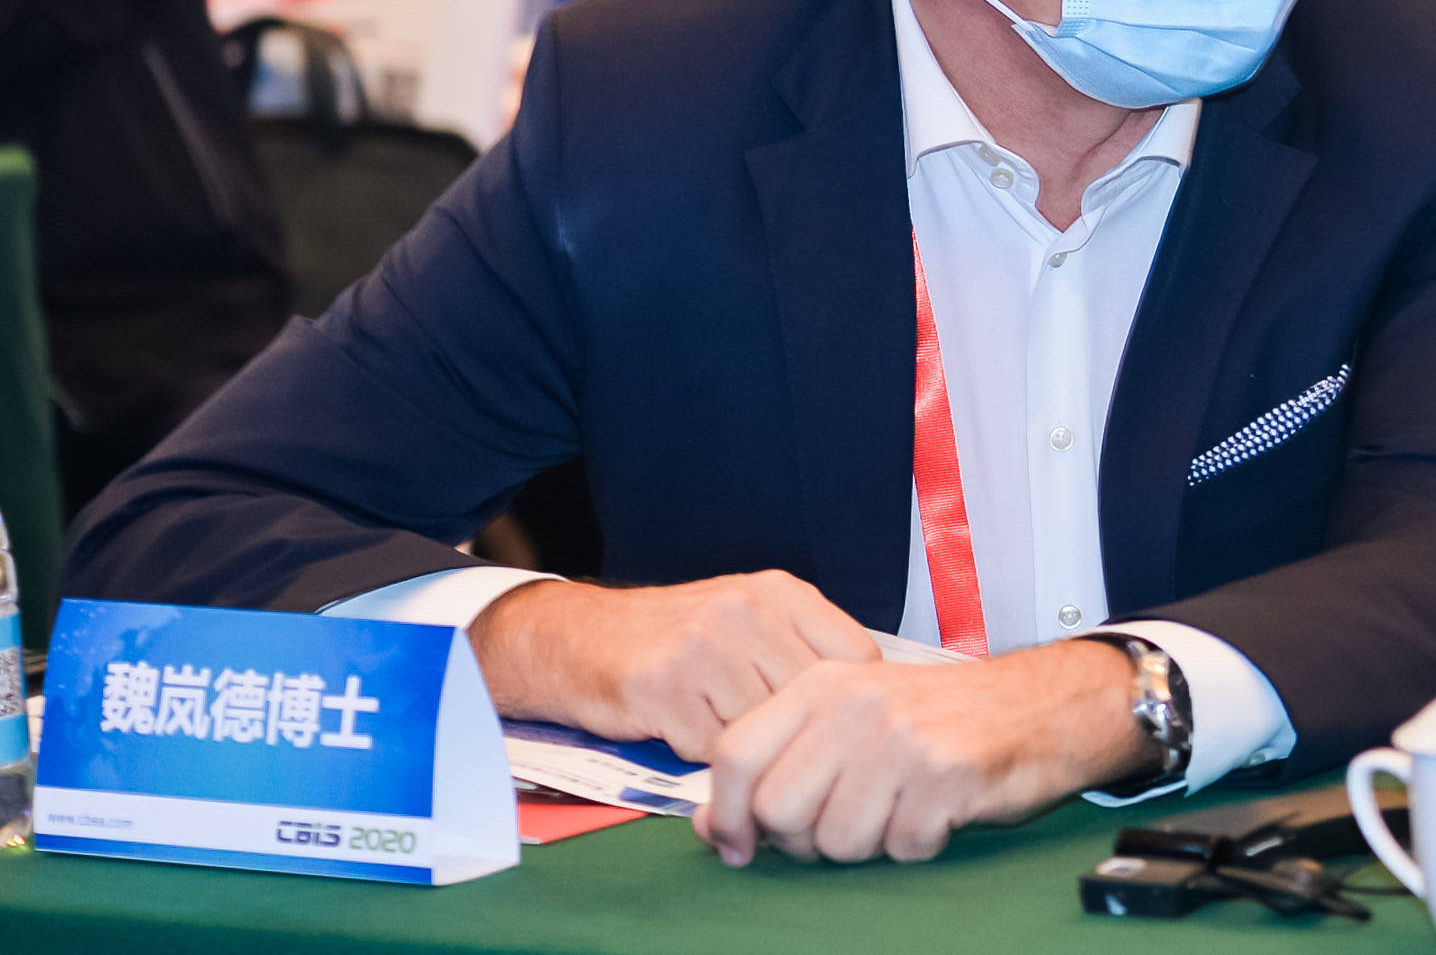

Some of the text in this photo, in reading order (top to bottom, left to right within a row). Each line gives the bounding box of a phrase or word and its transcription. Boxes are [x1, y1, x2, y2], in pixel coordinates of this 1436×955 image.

[100, 661, 380, 750] 魏岚德博士
[349, 827, 417, 854] 2020
